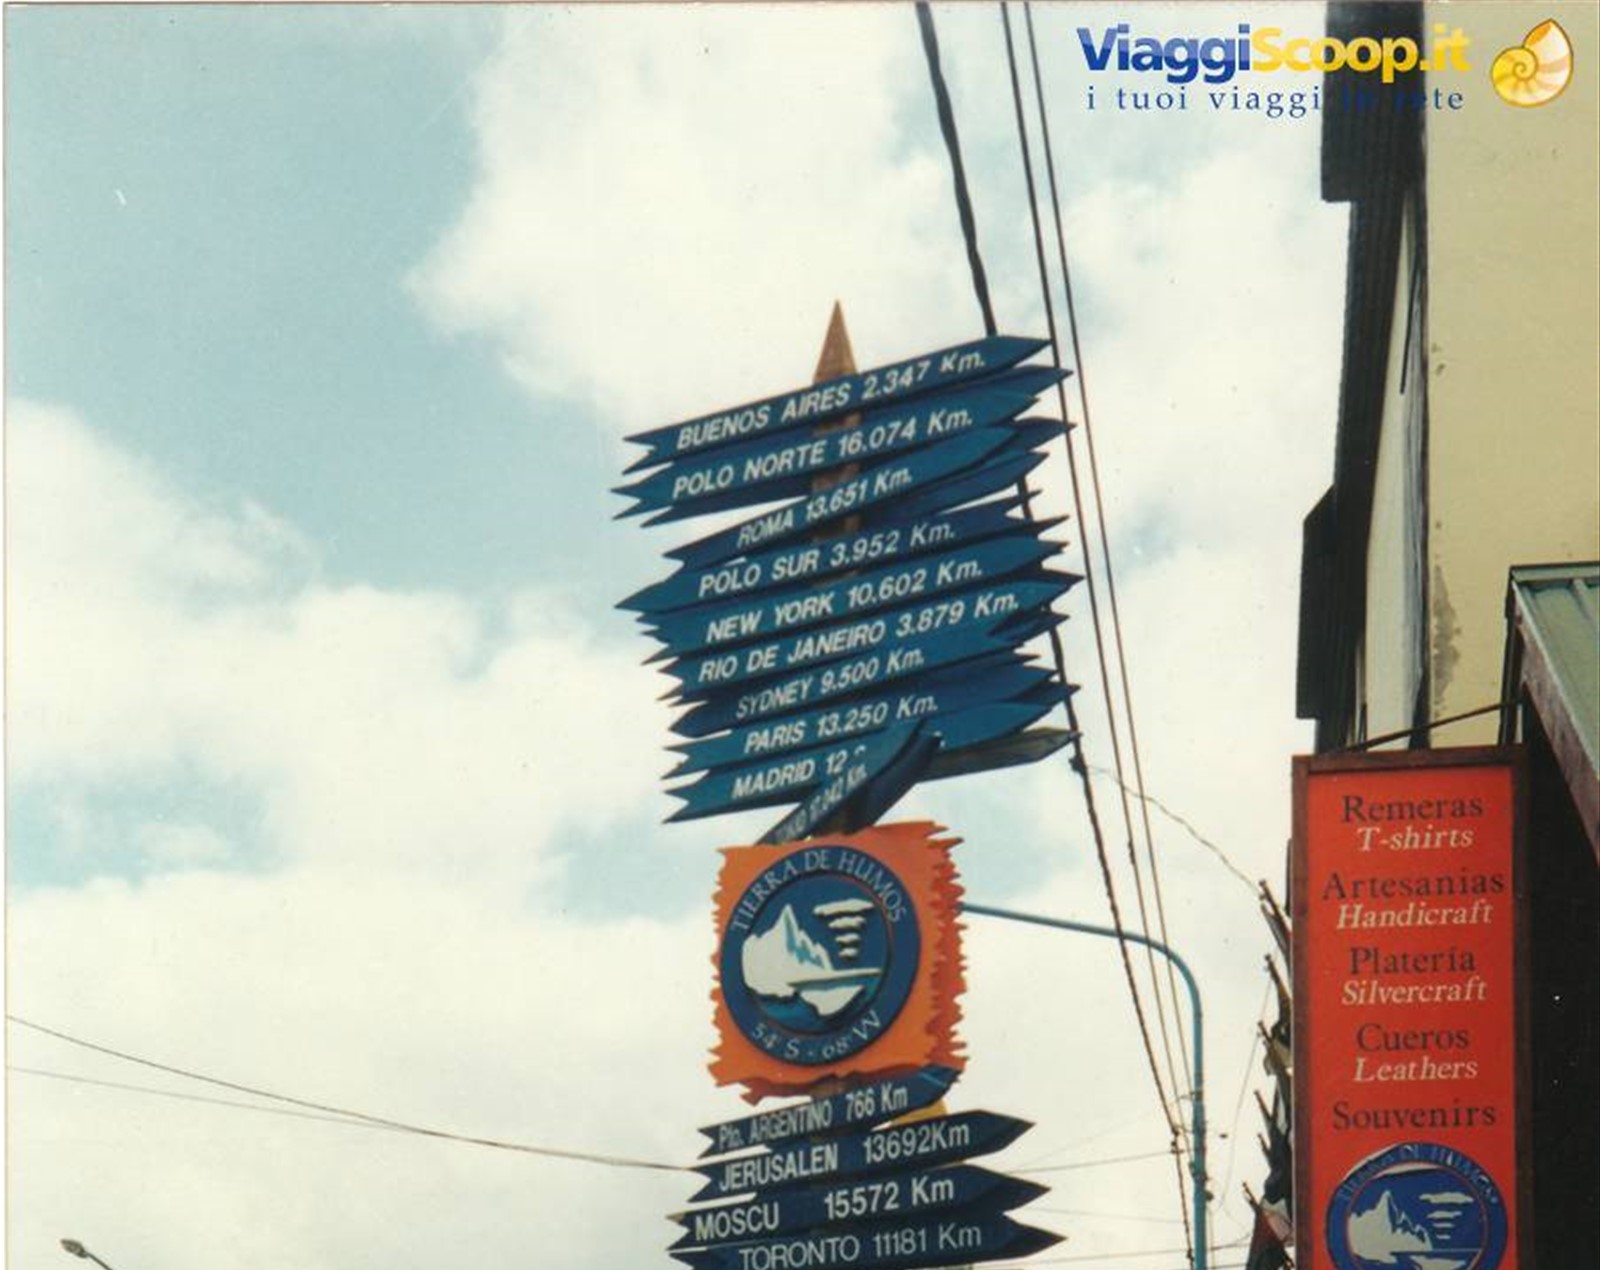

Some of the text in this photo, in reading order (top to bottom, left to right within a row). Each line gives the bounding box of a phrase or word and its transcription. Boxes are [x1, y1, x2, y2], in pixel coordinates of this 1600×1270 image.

[677, 350, 986, 451] BUENOS AIRES 2.347 Km.
[673, 407, 973, 500] POLO NORTE 16.074 Km.
[738, 465, 913, 549] ROMA 13.651 Km.
[700, 518, 956, 598] POLO SUR 3.952 Km.
[707, 557, 983, 642] NEW YORK 10.602 Km.
[698, 592, 1020, 682] RIO DE JANEIRO 3.879 Km.
[736, 646, 925, 720] SYDNEY 9.500 Km.
[744, 692, 939, 755] PARIS 13.250 Km.
[732, 760, 815, 799] MADRID
[1341, 794, 1484, 824] Remeras
[1357, 824, 1475, 853] T-shirts
[731, 850, 906, 932] TIERRA DE HUMOS
[1323, 867, 1505, 901] Artesanias
[1336, 898, 1494, 930] Handicraft
[1341, 976, 1487, 1007] Silvercraft
[1356, 1022, 1470, 1051] Cueros
[1353, 1056, 1478, 1083] Leathers
[751, 1101, 832, 1141] ARGENTINO
[845, 1089, 875, 1122] 766
[881, 1082, 908, 1112] Km
[1332, 1098, 1497, 1130] Souvenirs
[719, 1143, 838, 1192] JERUSALEN
[695, 1174, 954, 1241] MOSCU 15572 Km
[873, 1227, 928, 1258] 11181
[938, 1221, 982, 1249] Km
